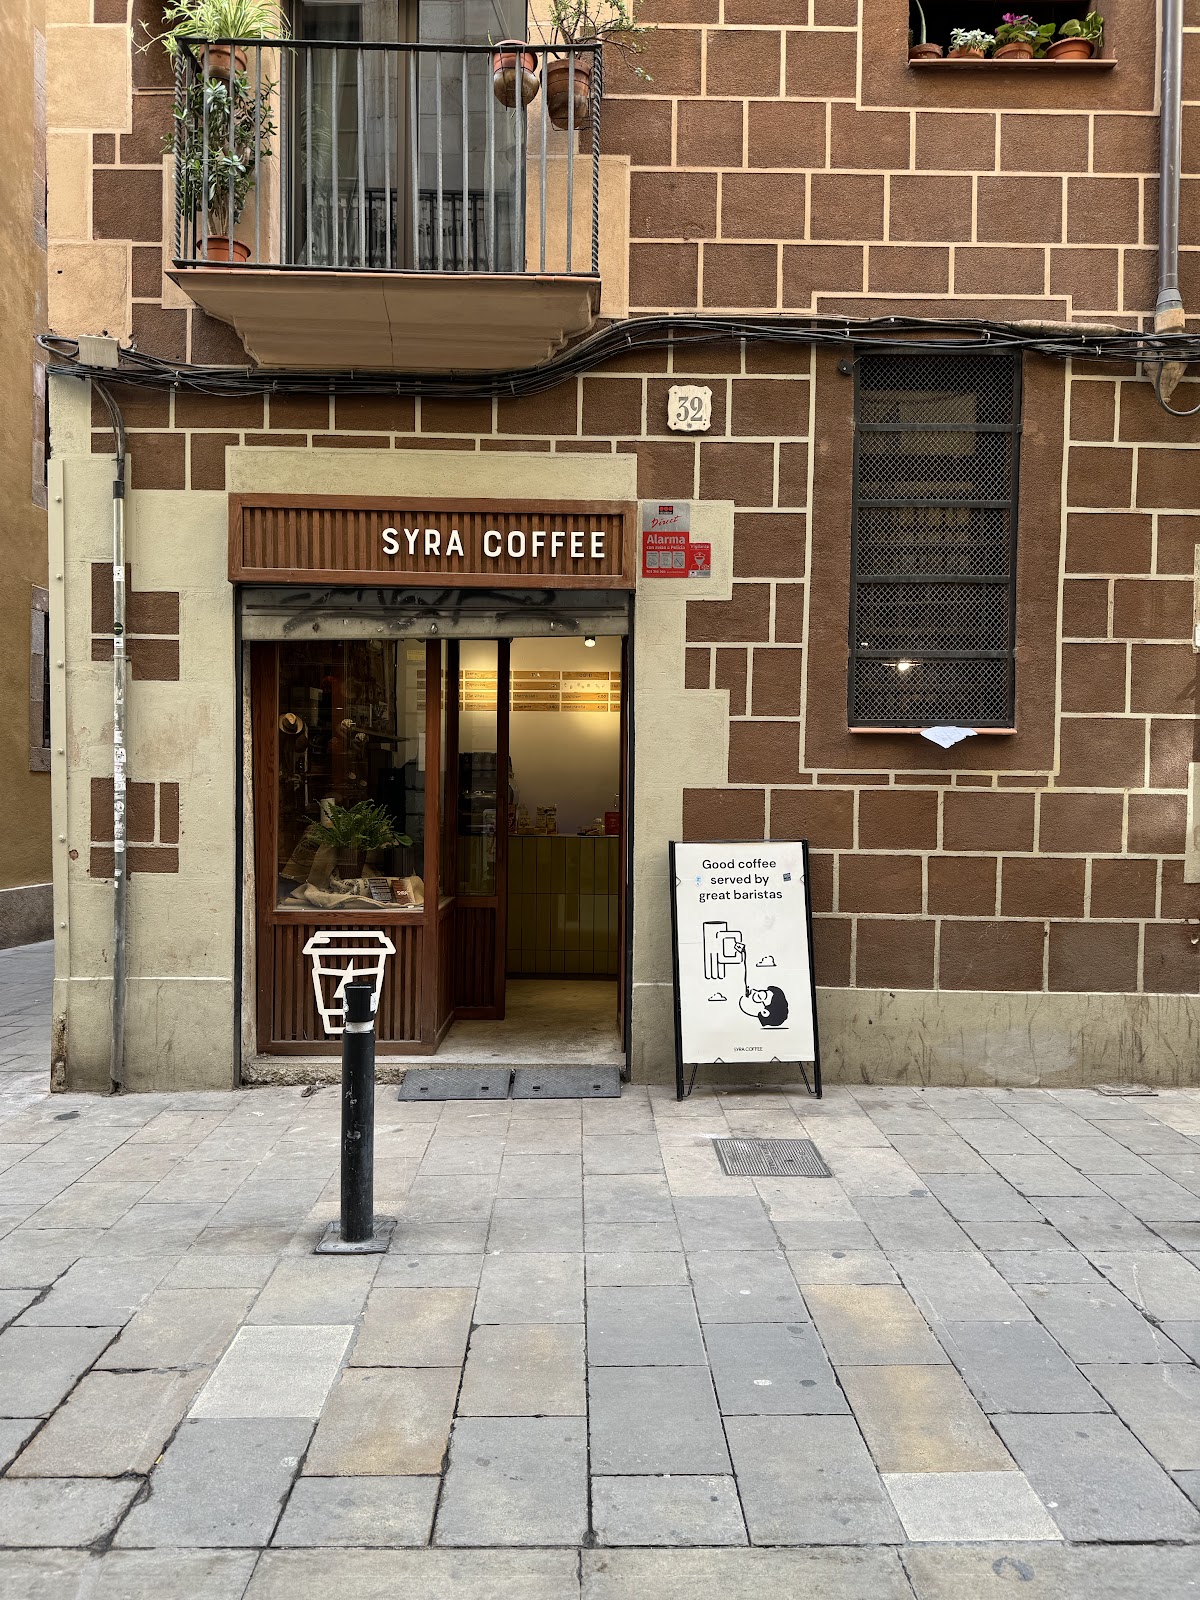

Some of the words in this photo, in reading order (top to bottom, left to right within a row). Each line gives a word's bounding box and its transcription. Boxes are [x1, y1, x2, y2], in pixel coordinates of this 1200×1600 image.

[382, 527, 464, 557] SYRA
[483, 530, 605, 558] COFFEE
[646, 534, 686, 544] Alarma
[702, 858, 735, 870] Good
[738, 858, 777, 869] coffee
[710, 873, 752, 885] served
[754, 873, 770, 887] by
[699, 890, 731, 904] great
[733, 889, 783, 900] baristas
